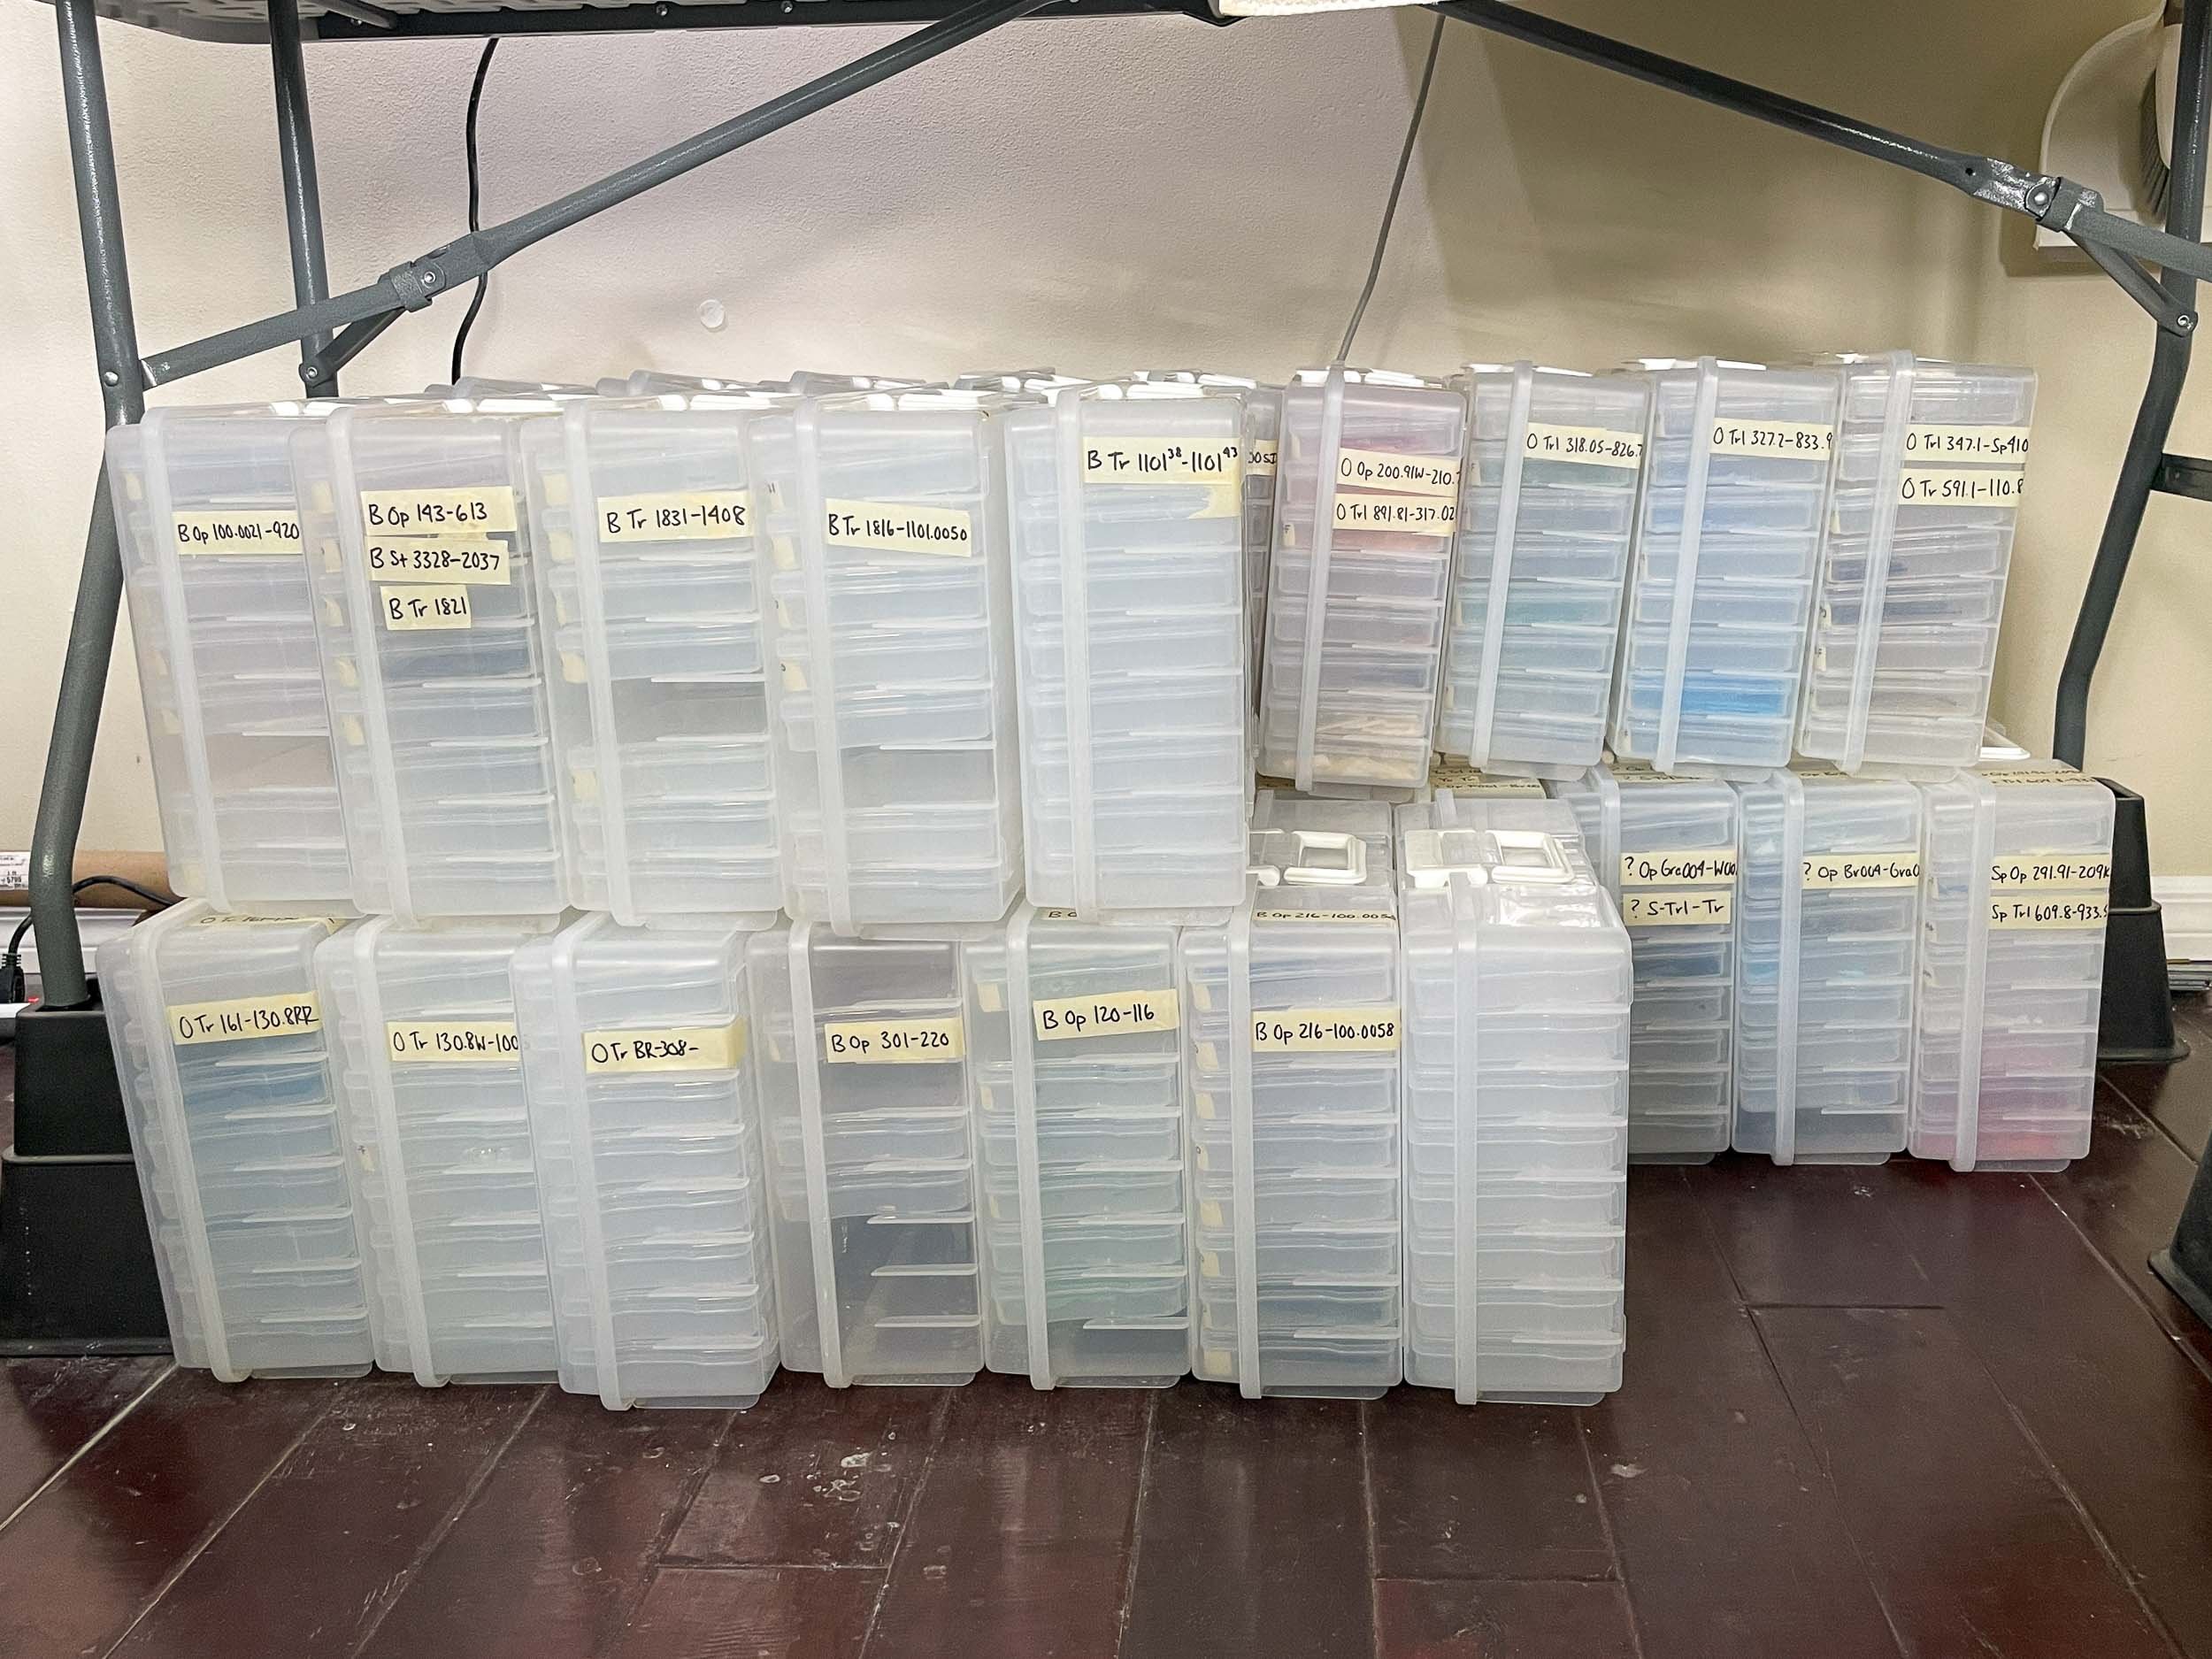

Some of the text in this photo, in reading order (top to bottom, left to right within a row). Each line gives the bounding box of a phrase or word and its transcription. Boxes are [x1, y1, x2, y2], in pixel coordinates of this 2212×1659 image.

[1087, 449, 1102, 471] B
[1107, 451, 1131, 472] Tr
[1356, 461, 1373, 480] Op
[1919, 480, 1938, 497] Tr
[368, 503, 384, 526] B
[386, 508, 411, 528] Op
[605, 503, 747, 534] B Tr 1831-1408
[827, 512, 841, 537] B
[841, 514, 861, 536] Tr
[177, 524, 190, 542] B
[192, 526, 209, 545] Op
[369, 547, 384, 569] B
[388, 596, 468, 620] B Tr 1821
[1624, 856, 1634, 877] ?
[1639, 861, 1658, 881] Op
[1802, 862, 1812, 881] ?
[1817, 866, 1838, 882] Op
[1991, 865, 2008, 884] Sp
[2009, 865, 2027, 884] Op
[1631, 899, 1640, 918] ?
[1992, 904, 2008, 923] Sp
[194, 1017, 215, 1033] Tr
[1043, 1003, 1155, 1032] B Op 120-116
[410, 1031, 429, 1050] Tr
[831, 1031, 949, 1053] B Op 301-220
[1256, 1022, 1395, 1044] B Op 216-100.0058
[612, 1042, 629, 1061] Tr
